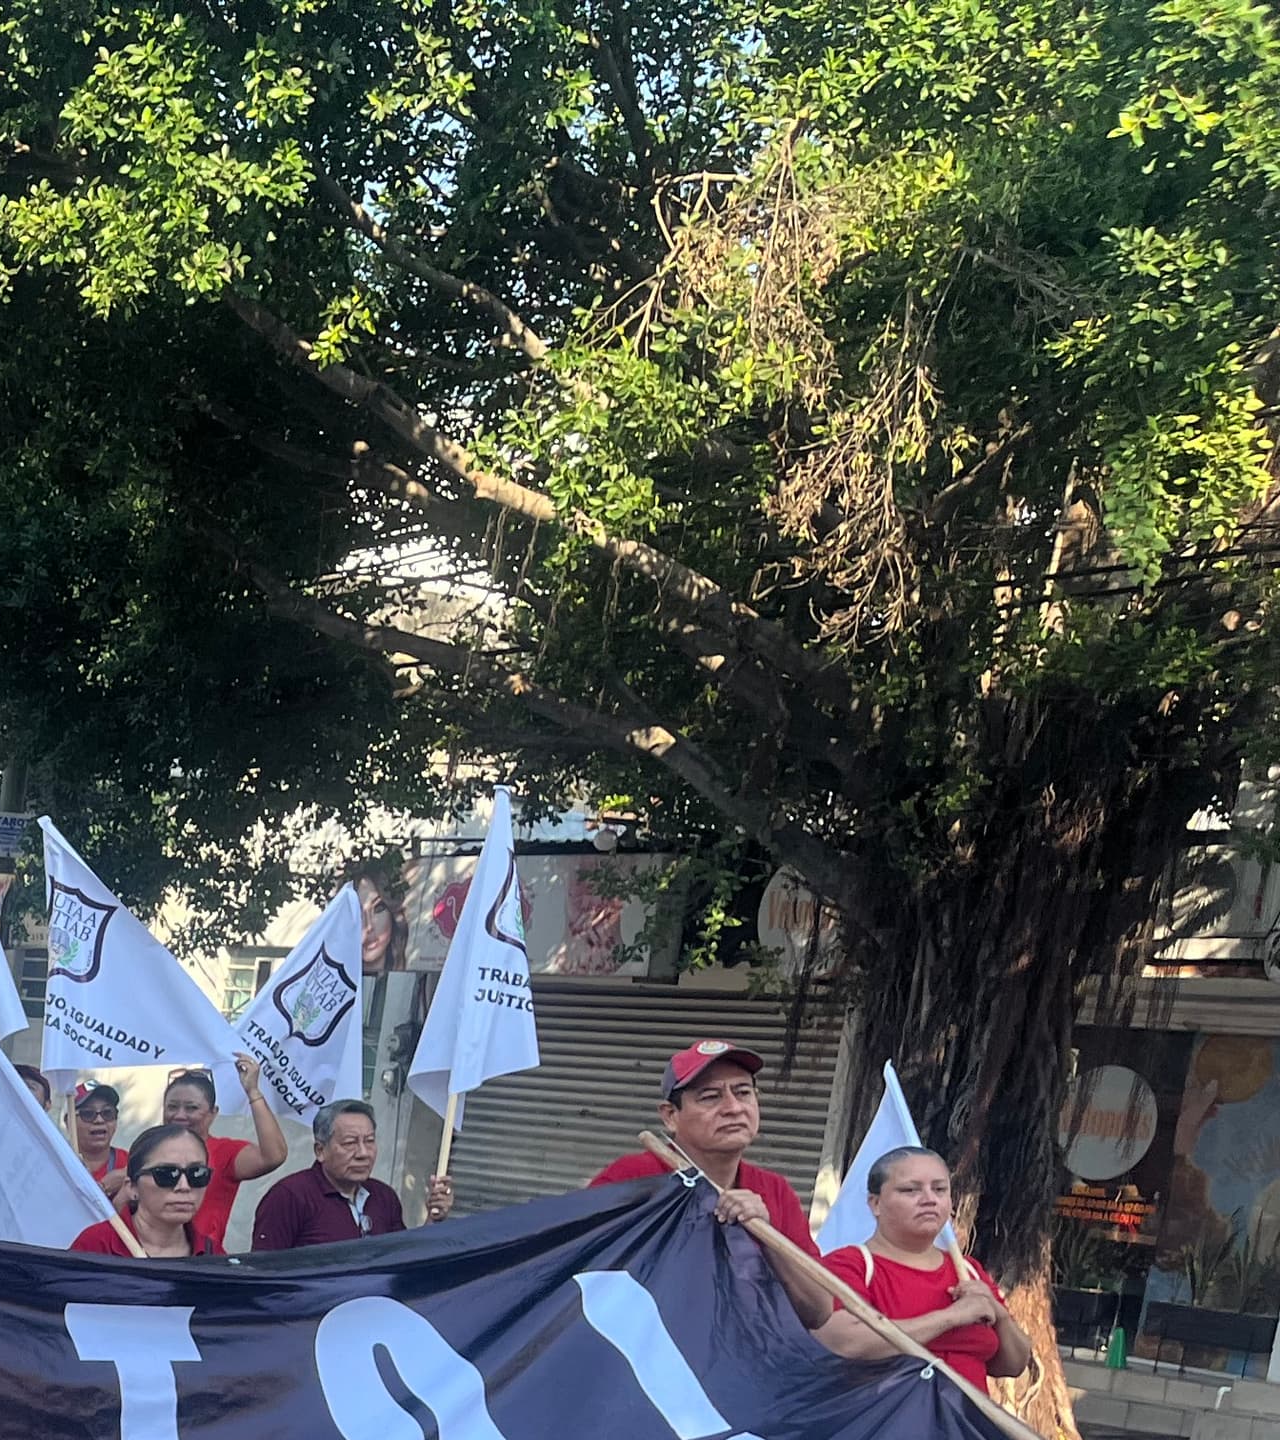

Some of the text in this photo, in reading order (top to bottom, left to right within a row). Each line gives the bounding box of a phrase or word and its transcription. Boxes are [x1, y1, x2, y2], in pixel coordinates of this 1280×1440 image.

[63, 1022, 113, 1062] SOCIAL
[70, 1006, 151, 1054] IGUALDAD
[154, 1045, 166, 1060] Y
